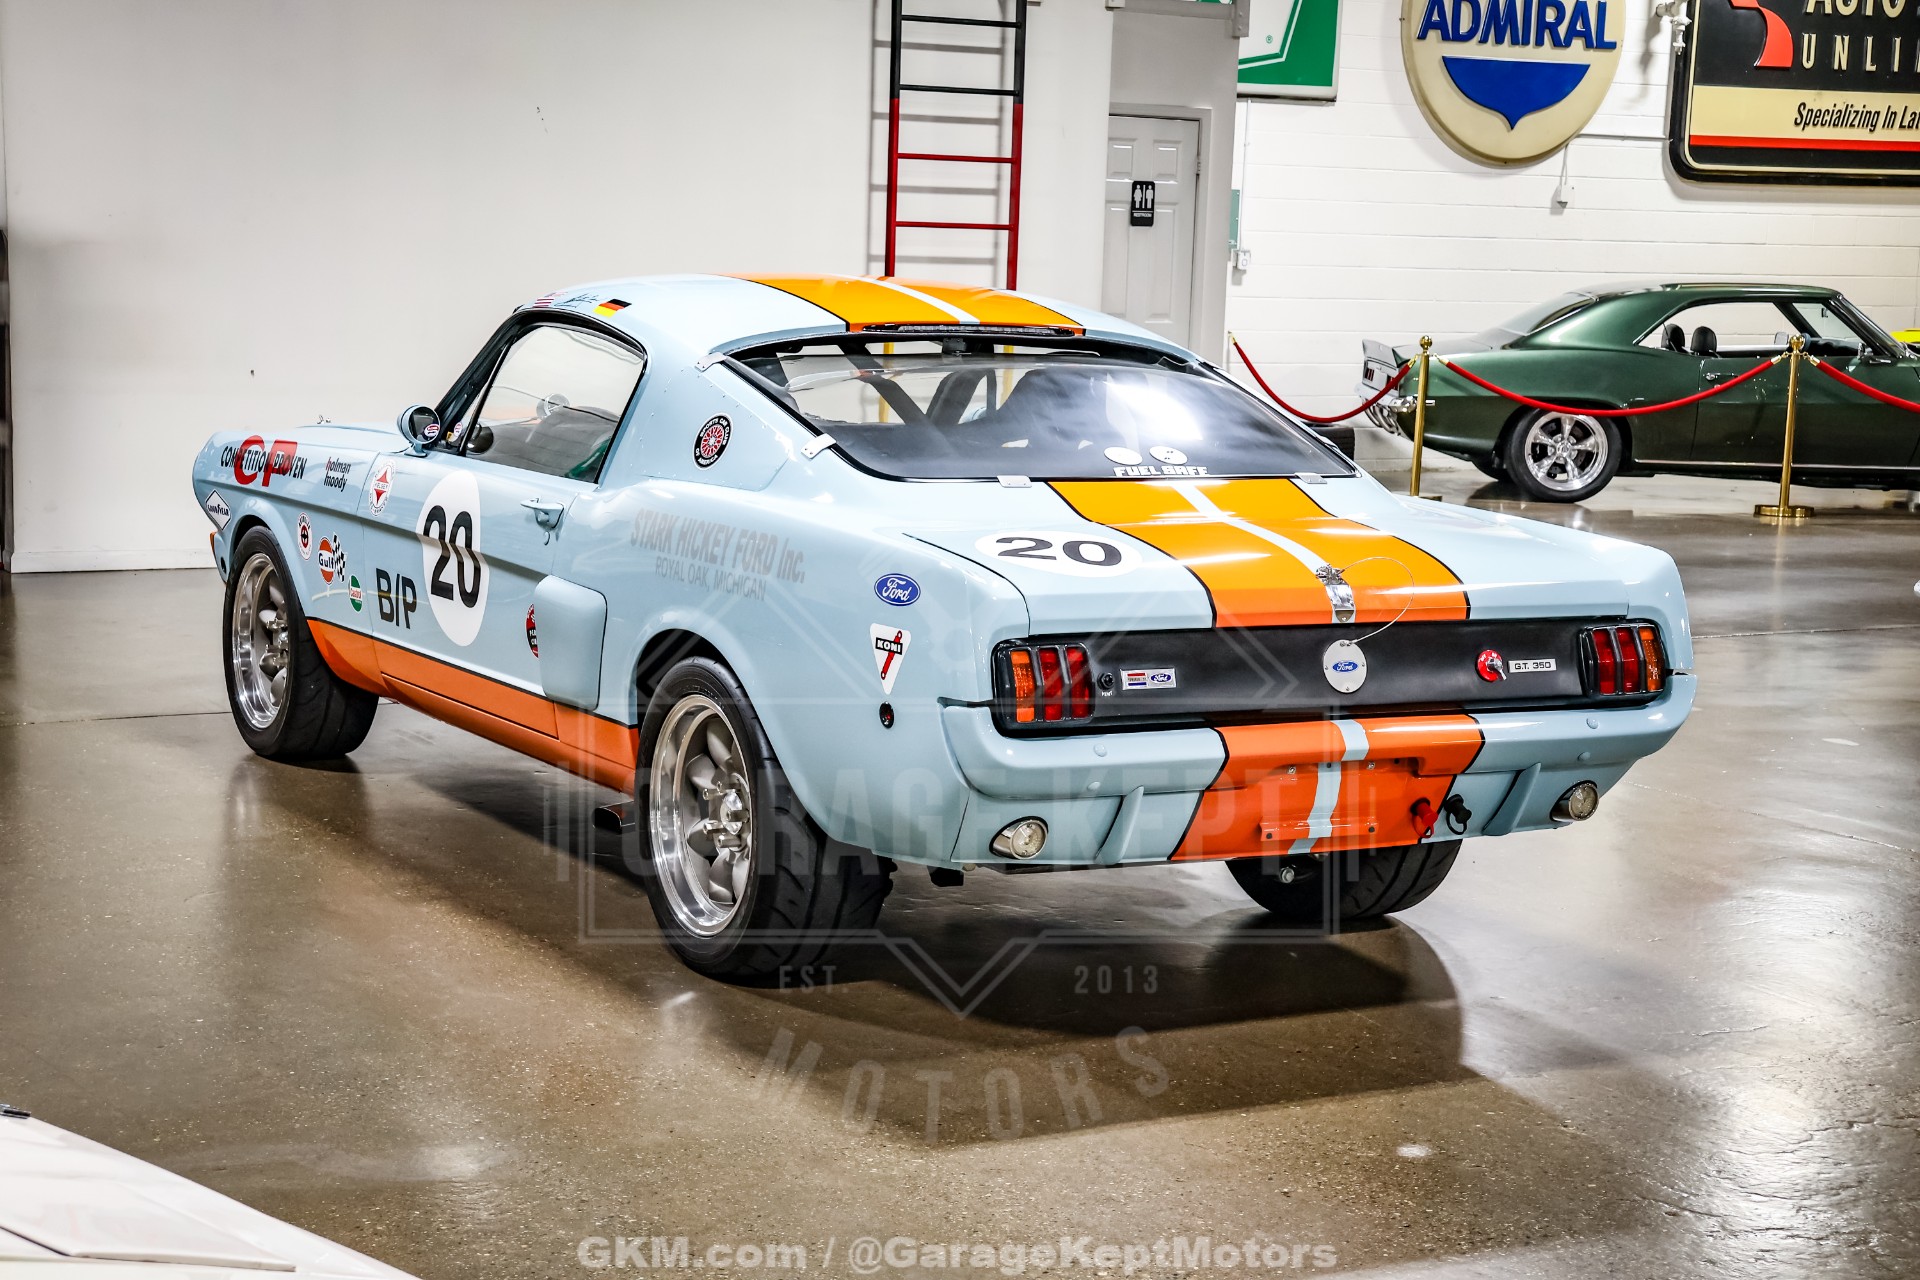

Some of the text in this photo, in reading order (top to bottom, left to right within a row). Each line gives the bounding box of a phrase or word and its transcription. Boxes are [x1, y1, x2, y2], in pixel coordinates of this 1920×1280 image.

[1416, 0, 1618, 50] ADMIRAL
[1802, 32, 1920, 74] UNLI
[1794, 102, 1881, 133] Specializing
[1881, 105, 1898, 130] In
[220, 445, 308, 480] COMPETITION PROVEN
[325, 456, 352, 475] holman
[1113, 465, 1161, 477] FUEL
[423, 504, 482, 609] 20
[630, 508, 806, 584] STARK HICKEY FORD Inc.
[995, 536, 1123, 567] 20
[318, 552, 337, 570] Gulf
[655, 556, 685, 583] ROYAL
[713, 569, 767, 601] MICHIGAN
[882, 577, 912, 602] Ford
[876, 639, 902, 654] KONI
[1152, 673, 1169, 683] Ford
[1336, 660, 1354, 672] Ford
[1532, 661, 1552, 669] 350
